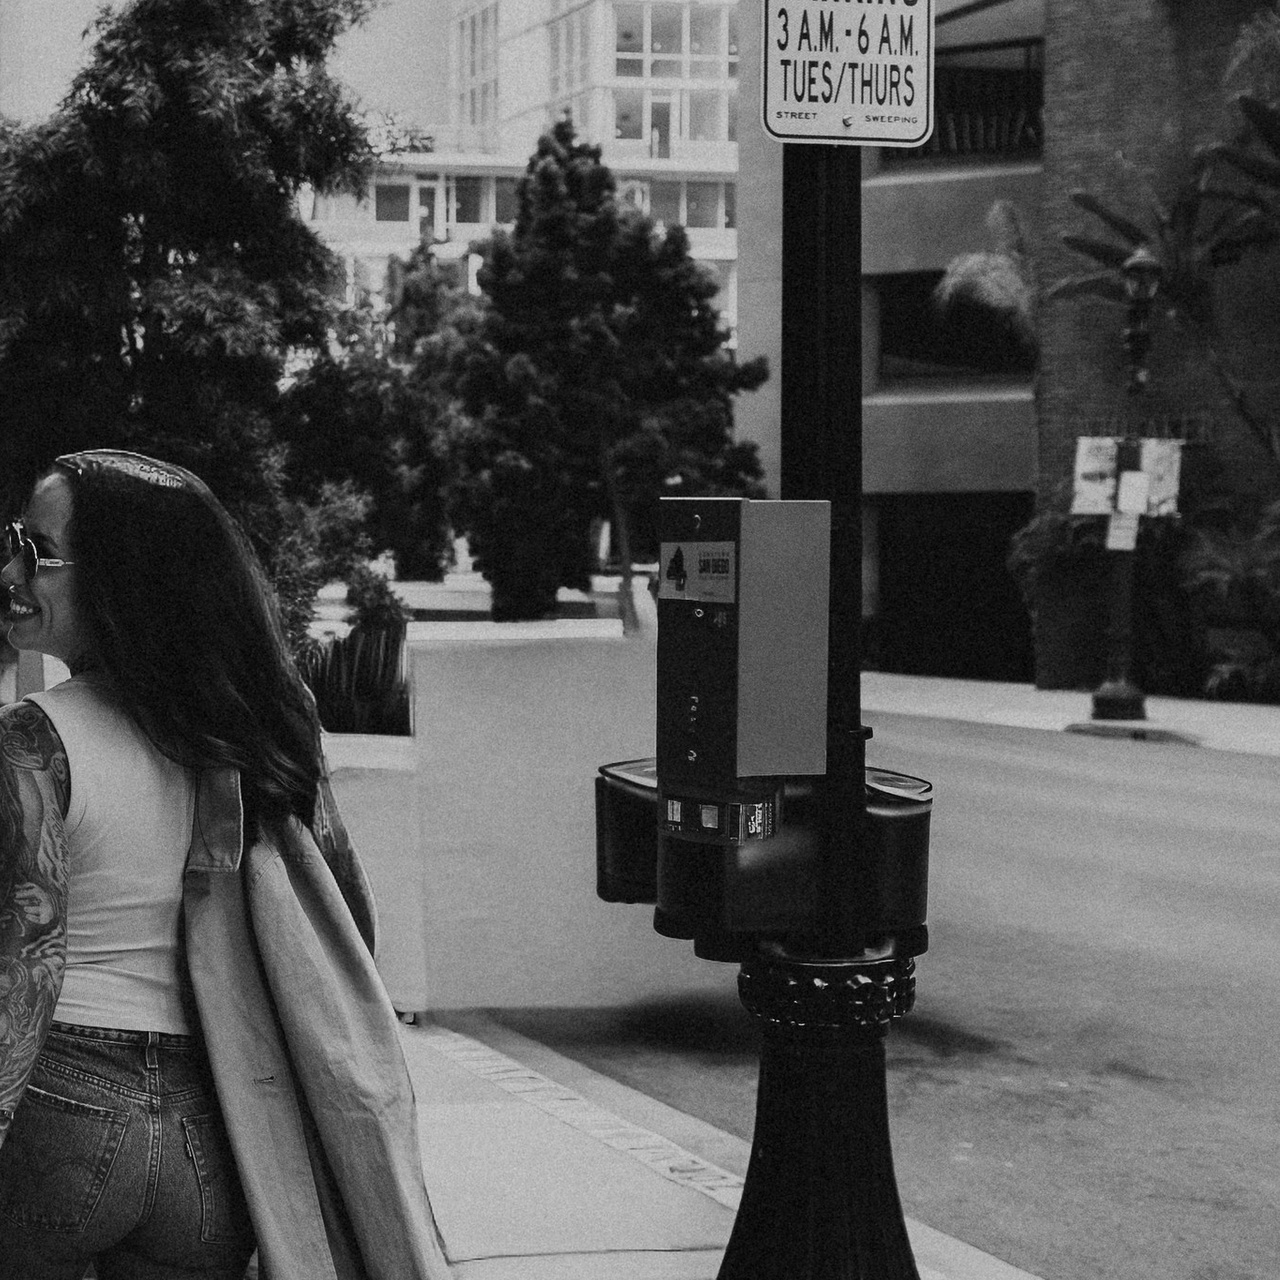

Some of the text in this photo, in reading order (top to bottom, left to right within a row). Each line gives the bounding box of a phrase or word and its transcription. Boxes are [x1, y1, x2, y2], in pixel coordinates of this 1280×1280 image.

[776, 7, 789, 52] 3
[797, 9, 839, 53] A.M.
[857, 13, 870, 55] 6
[878, 13, 918, 56] A.M.
[780, 59, 915, 107] TUES/THURS
[776, 111, 918, 124] STREET SWEEPING
